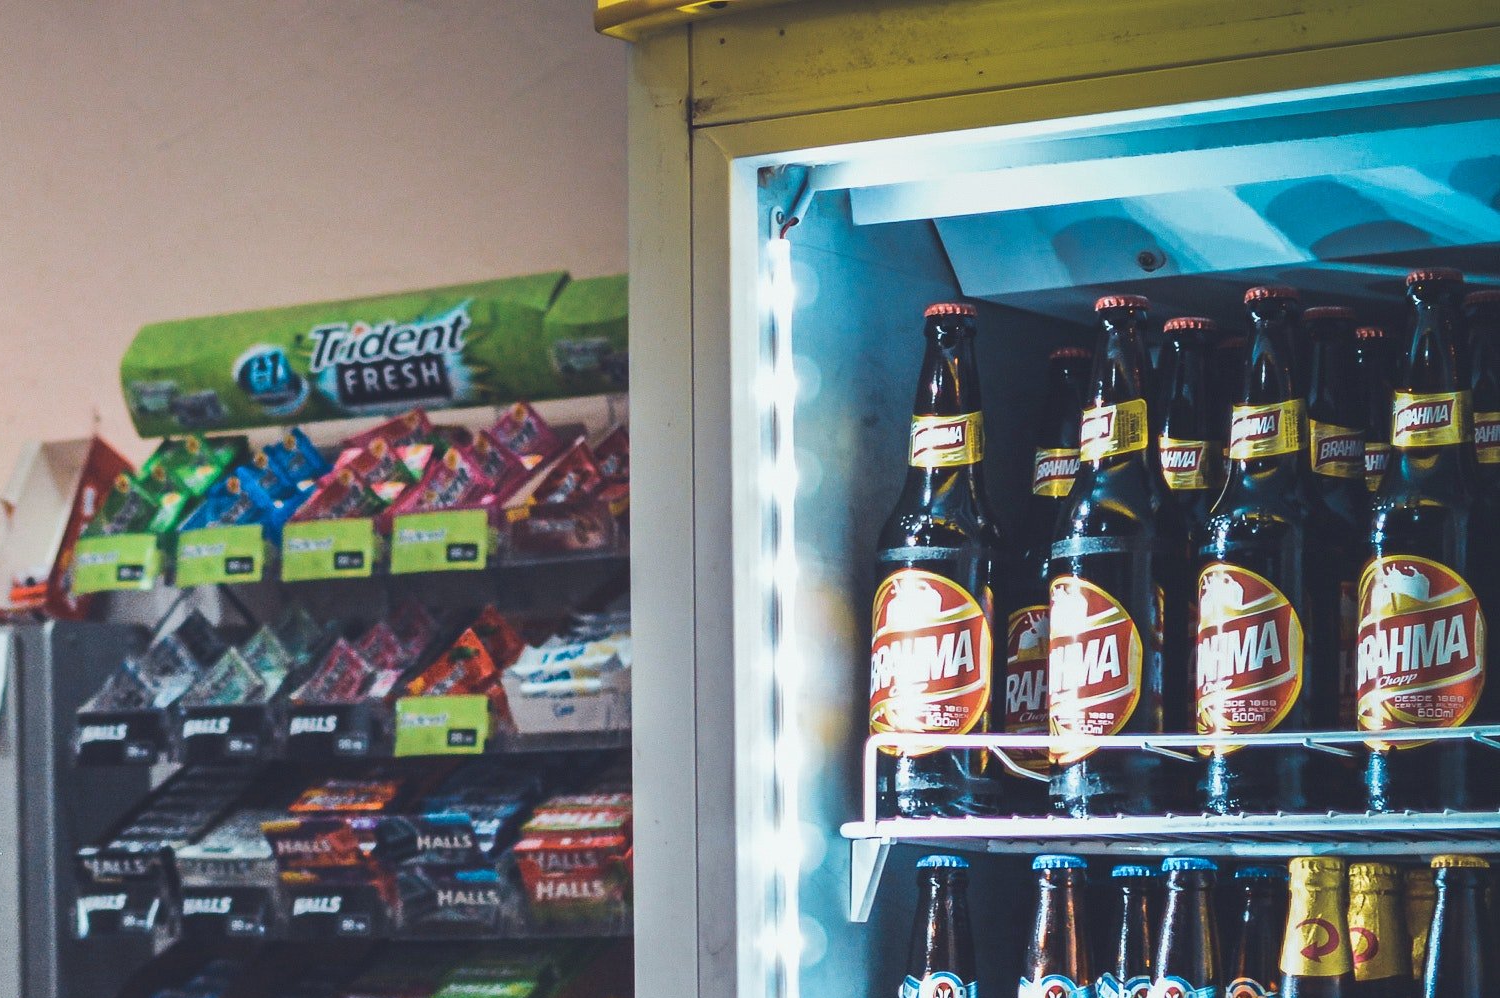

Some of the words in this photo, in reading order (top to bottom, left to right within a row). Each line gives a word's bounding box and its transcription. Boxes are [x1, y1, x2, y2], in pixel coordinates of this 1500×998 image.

[311, 314, 467, 371] Trident
[345, 361, 440, 394] FRESH
[1378, 672, 1418, 689] Chopp
[1417, 707, 1455, 719] 600ml
[416, 833, 474, 850] HALLS
[436, 889, 500, 906] HALLS
[535, 880, 606, 900] HALLS
